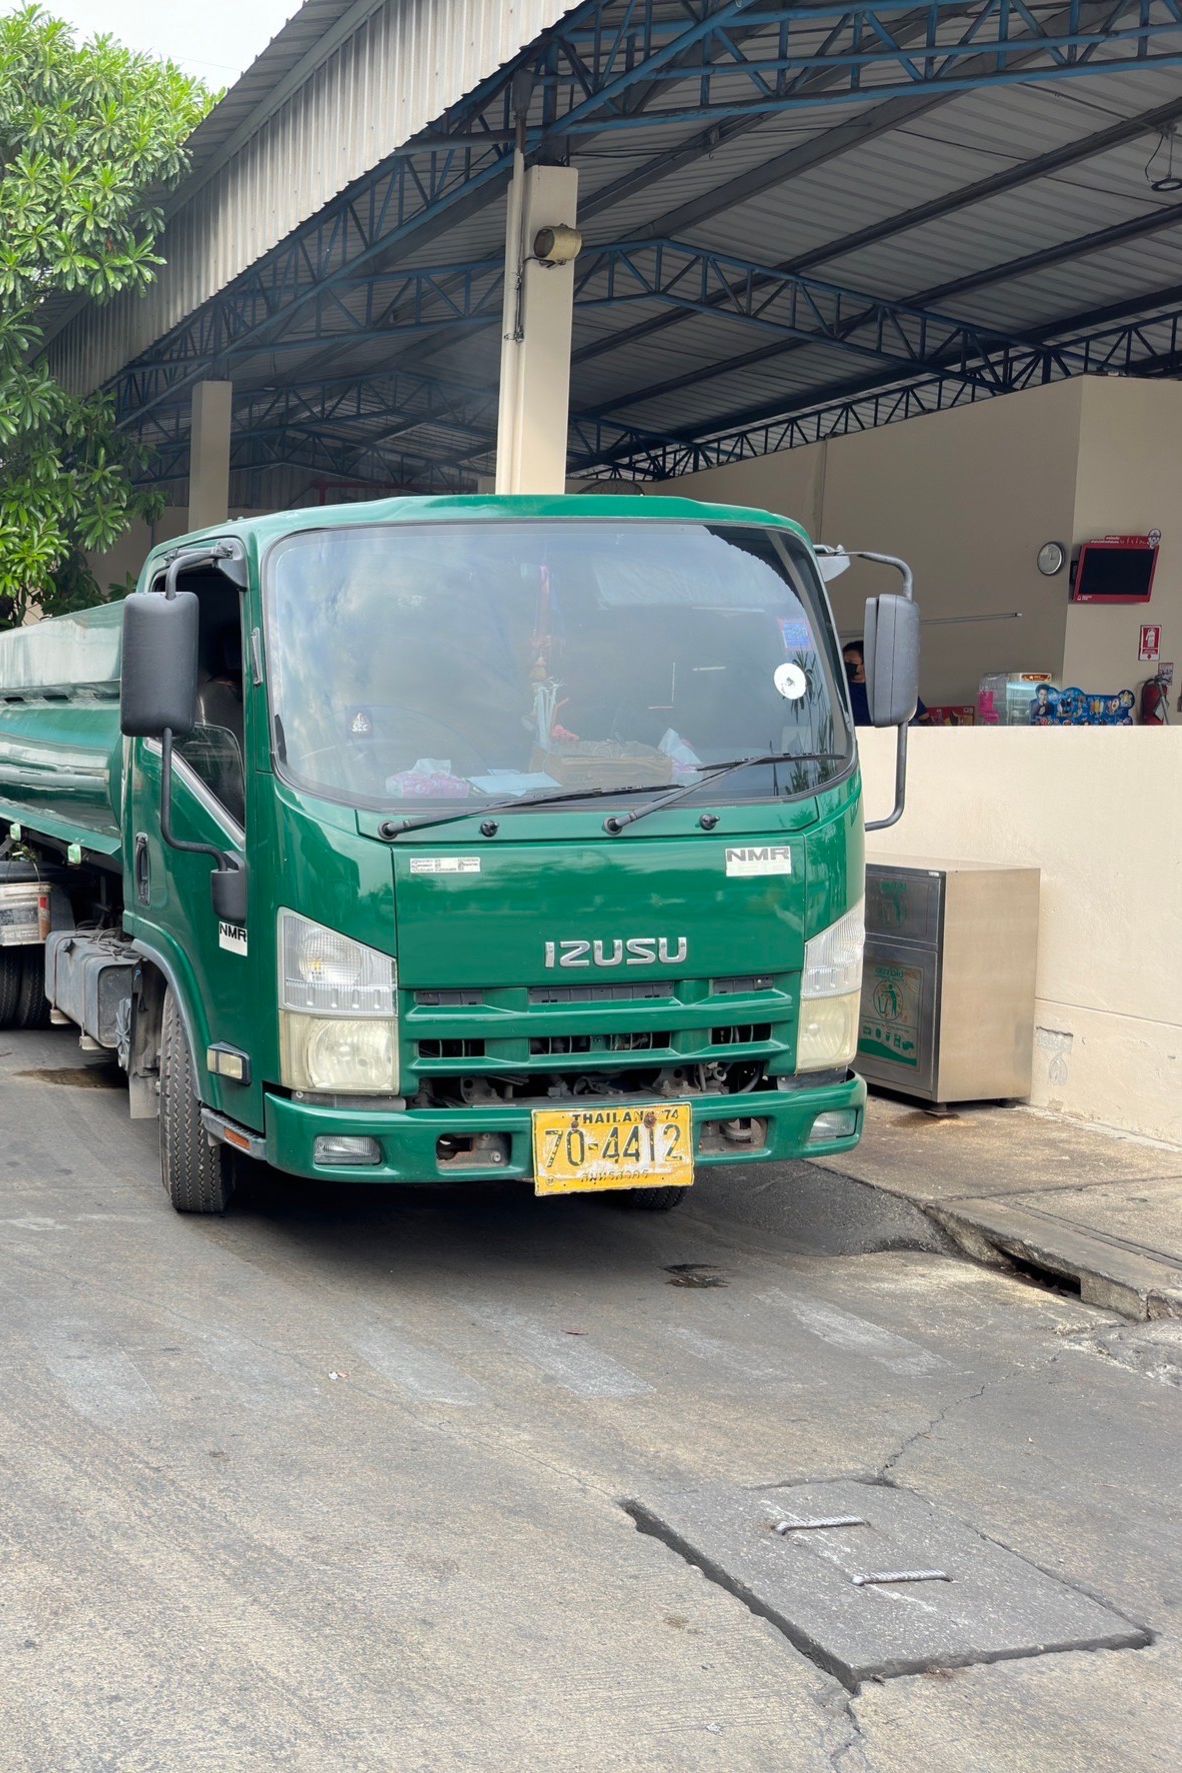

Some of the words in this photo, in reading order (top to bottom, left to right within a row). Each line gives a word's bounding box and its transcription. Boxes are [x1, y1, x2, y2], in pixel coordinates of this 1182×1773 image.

[726, 847, 790, 862] NMR
[219, 922, 247, 943] NMR
[544, 936, 687, 968] IZUSU
[572, 1111, 655, 1125] THAILAN
[545, 1123, 683, 1168] 70-4412
